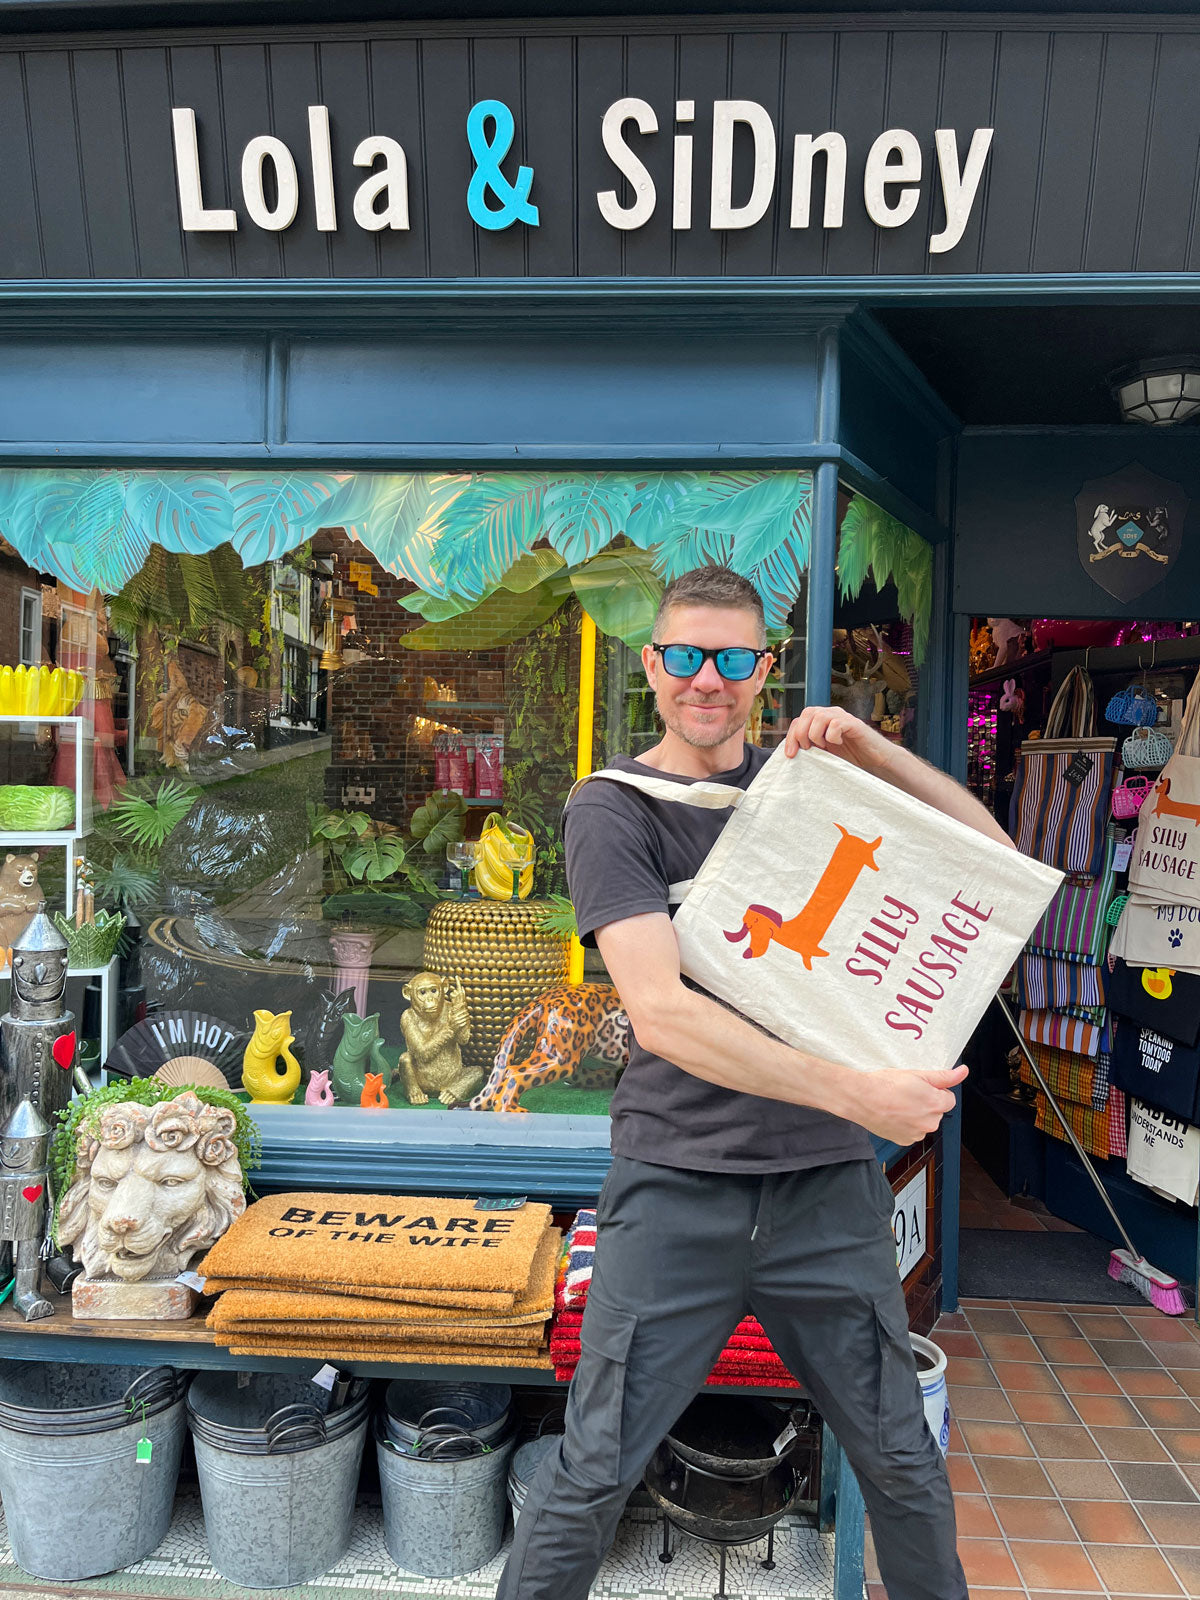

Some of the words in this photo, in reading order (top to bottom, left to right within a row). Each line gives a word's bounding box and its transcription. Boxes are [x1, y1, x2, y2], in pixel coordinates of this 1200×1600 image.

[172, 104, 410, 233] Lola
[466, 98, 541, 232] &
[596, 97, 994, 255] SiDney
[1151, 826, 1187, 850] SILLY
[1138, 849, 1198, 880] SAUSAGE
[1156, 904, 1175, 923] MY
[845, 894, 919, 986] SILLY
[885, 889, 994, 1040] SAUSAGE
[151, 1018, 187, 1048] I'M
[193, 1019, 235, 1053] HOT
[1141, 1053, 1163, 1073] TODAY
[1143, 1133, 1156, 1148] ME
[280, 1207, 515, 1233] BEWARE
[268, 1227, 318, 1238] OF
[329, 1230, 396, 1244] THE
[408, 1235, 503, 1248] WIFE
